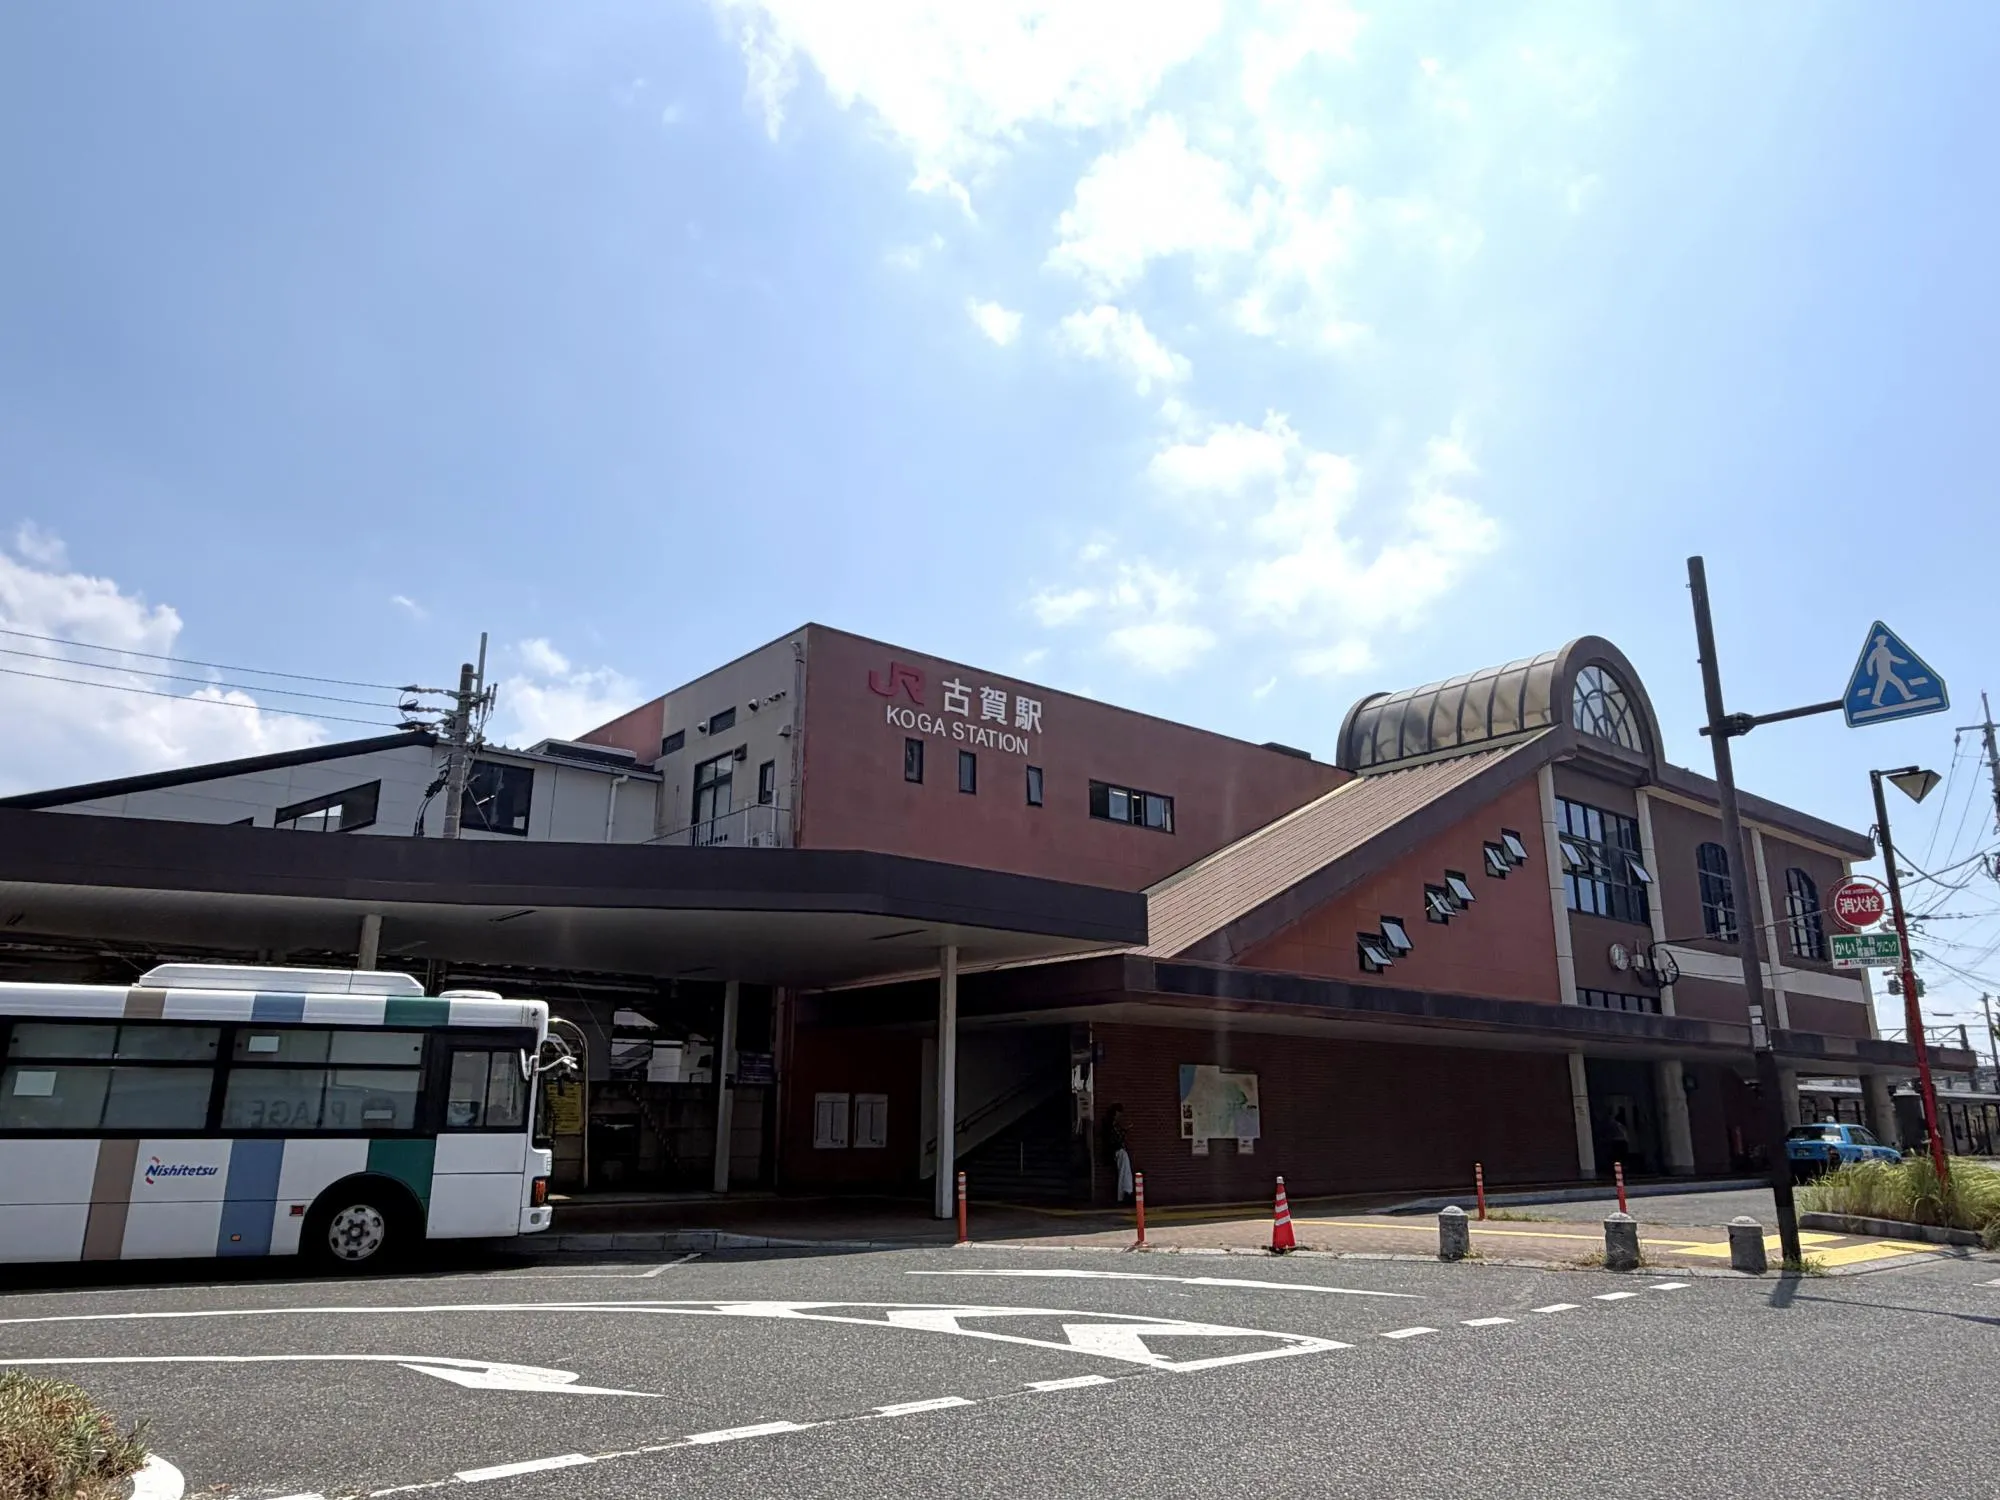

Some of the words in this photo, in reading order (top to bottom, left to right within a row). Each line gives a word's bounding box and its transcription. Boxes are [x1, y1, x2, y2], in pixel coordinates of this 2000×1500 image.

[869, 662, 924, 705] JR
[942, 678, 1043, 734] 古賀駅
[886, 705, 946, 737] KOGA
[952, 721, 1029, 756] STATION
[1839, 895, 1881, 915] 消火栓
[145, 1164, 219, 1177] Nishitetsu
